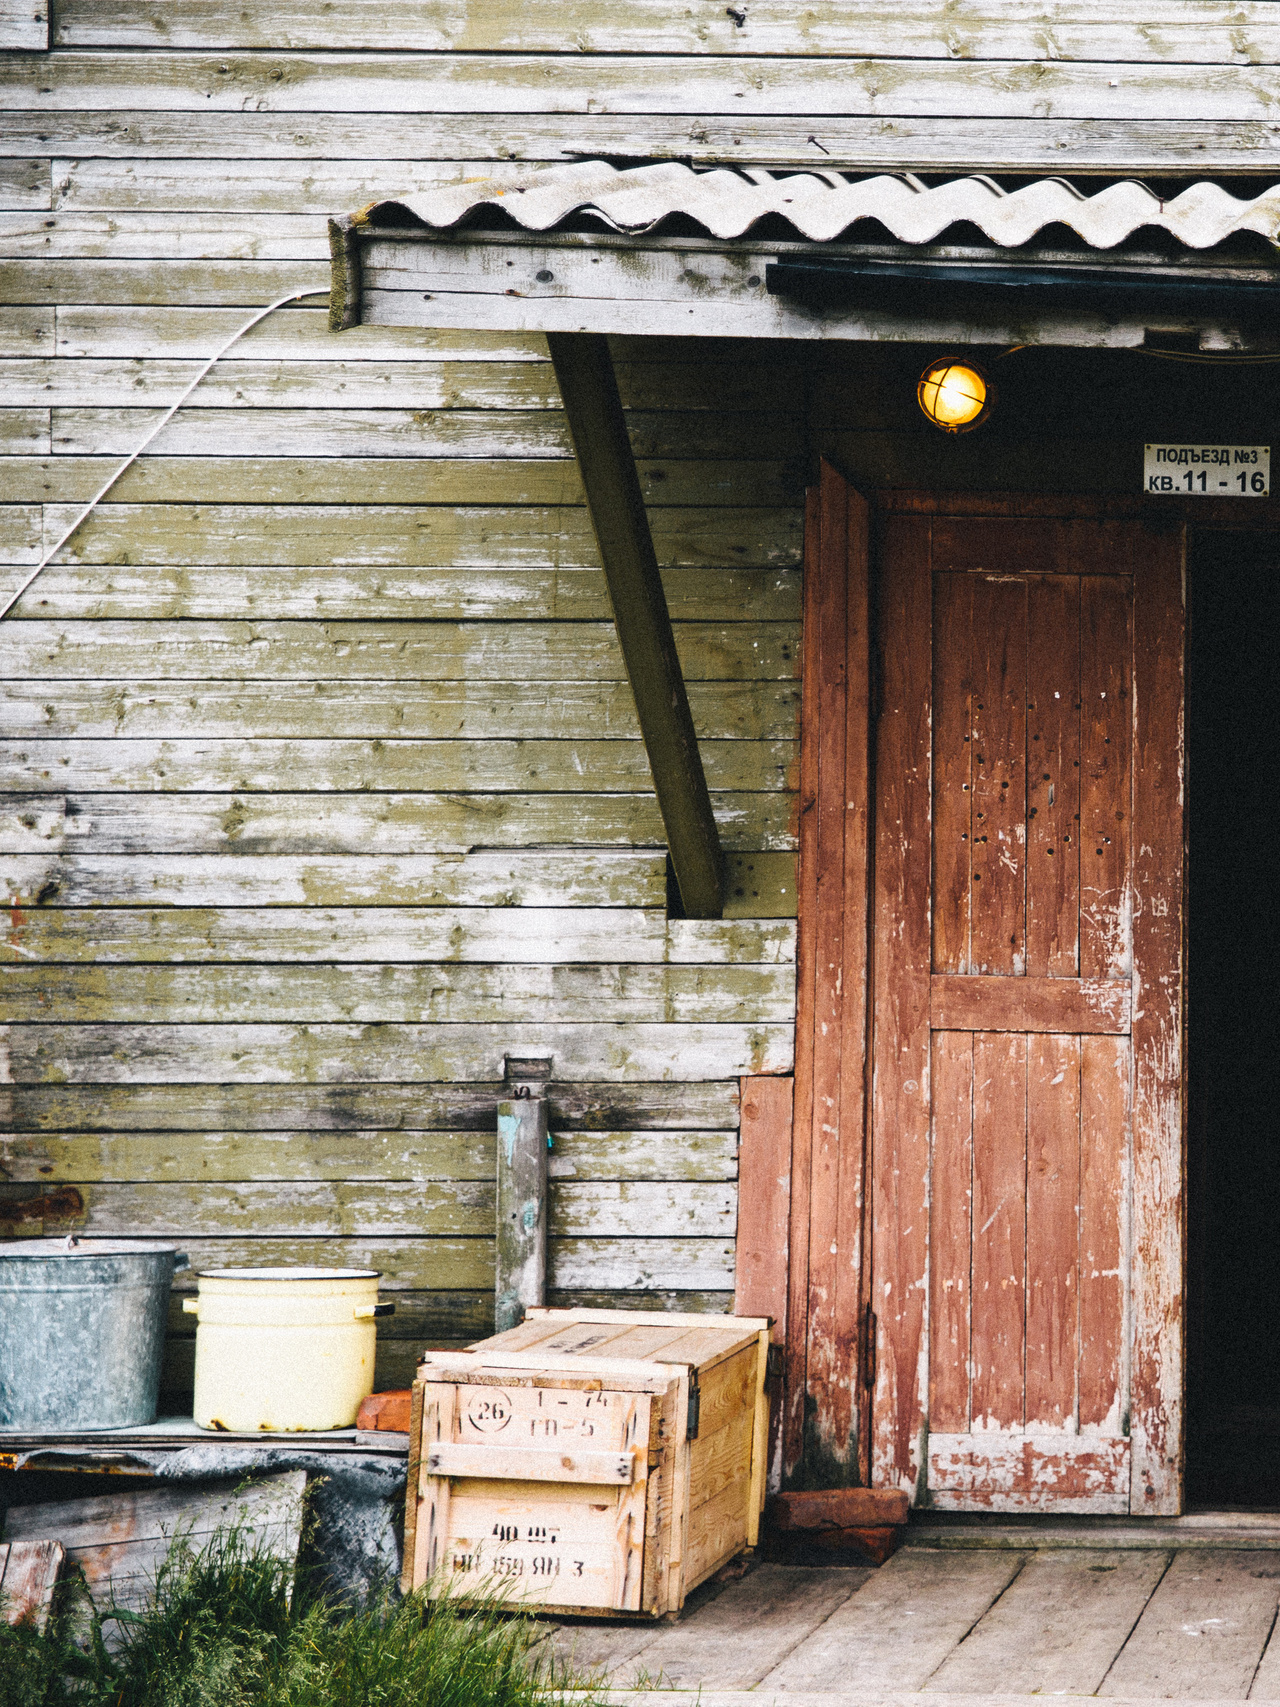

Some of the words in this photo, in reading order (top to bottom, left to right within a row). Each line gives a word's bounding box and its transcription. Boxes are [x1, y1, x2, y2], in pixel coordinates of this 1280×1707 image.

[1156, 448, 1230, 466] ПОДЪЕЗД
[1234, 449, 1258, 464] №3
[1236, 471, 1265, 492] 16
[478, 1402, 504, 1420] 26
